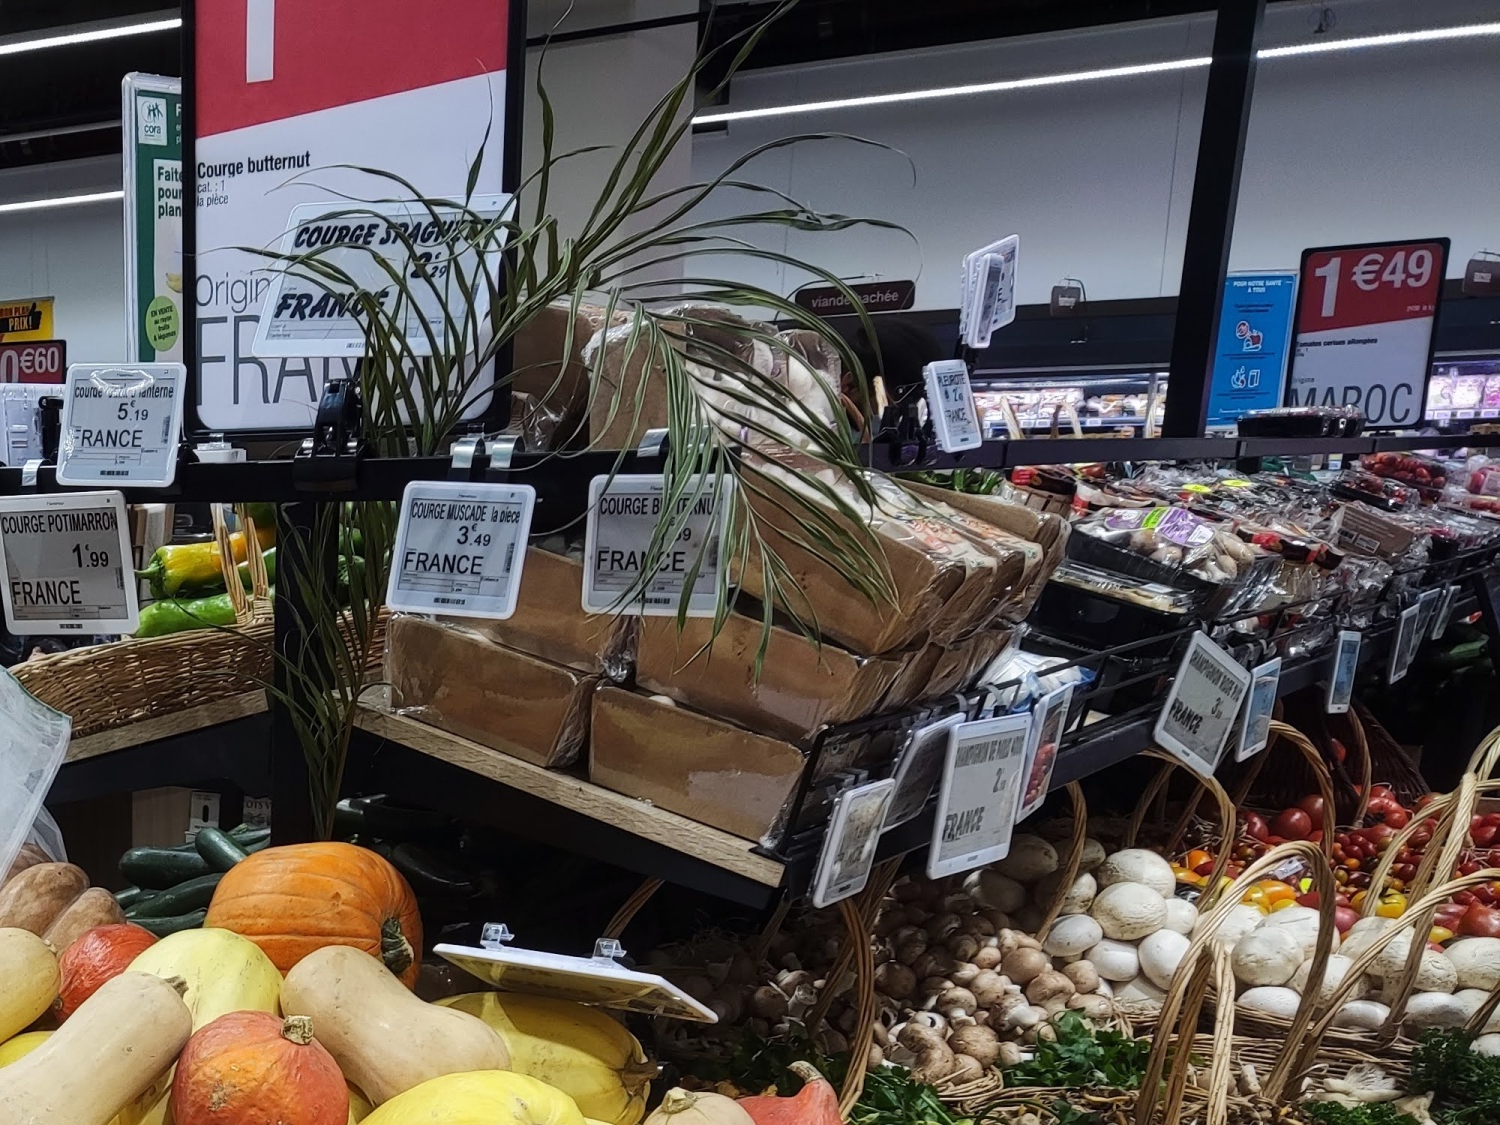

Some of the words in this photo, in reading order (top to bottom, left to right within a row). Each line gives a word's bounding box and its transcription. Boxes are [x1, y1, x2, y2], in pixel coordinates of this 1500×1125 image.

[144, 124, 162, 135] cora
[197, 161, 244, 179] Courge
[247, 150, 311, 174] butternut
[295, 224, 379, 248] COURGE
[380, 217, 494, 246] SPAGH
[196, 272, 270, 314] Origin
[811, 294, 851, 308] viande
[1289, 382, 1413, 424] MAROC
[75, 429, 143, 448] FRANCE
[411, 502, 446, 520] COURGE
[446, 503, 488, 522] MUSCADE
[490, 506, 499, 523] la
[600, 497, 649, 515] COURGE
[652, 497, 720, 516] BTENU
[2, 514, 47, 535] COURGE
[47, 511, 118, 533] POTIMARRON
[403, 551, 484, 575] FRANCE
[11, 580, 82, 606] FRANCE
[1168, 696, 1204, 736] FRANCE
[942, 806, 985, 843] FRANCE
